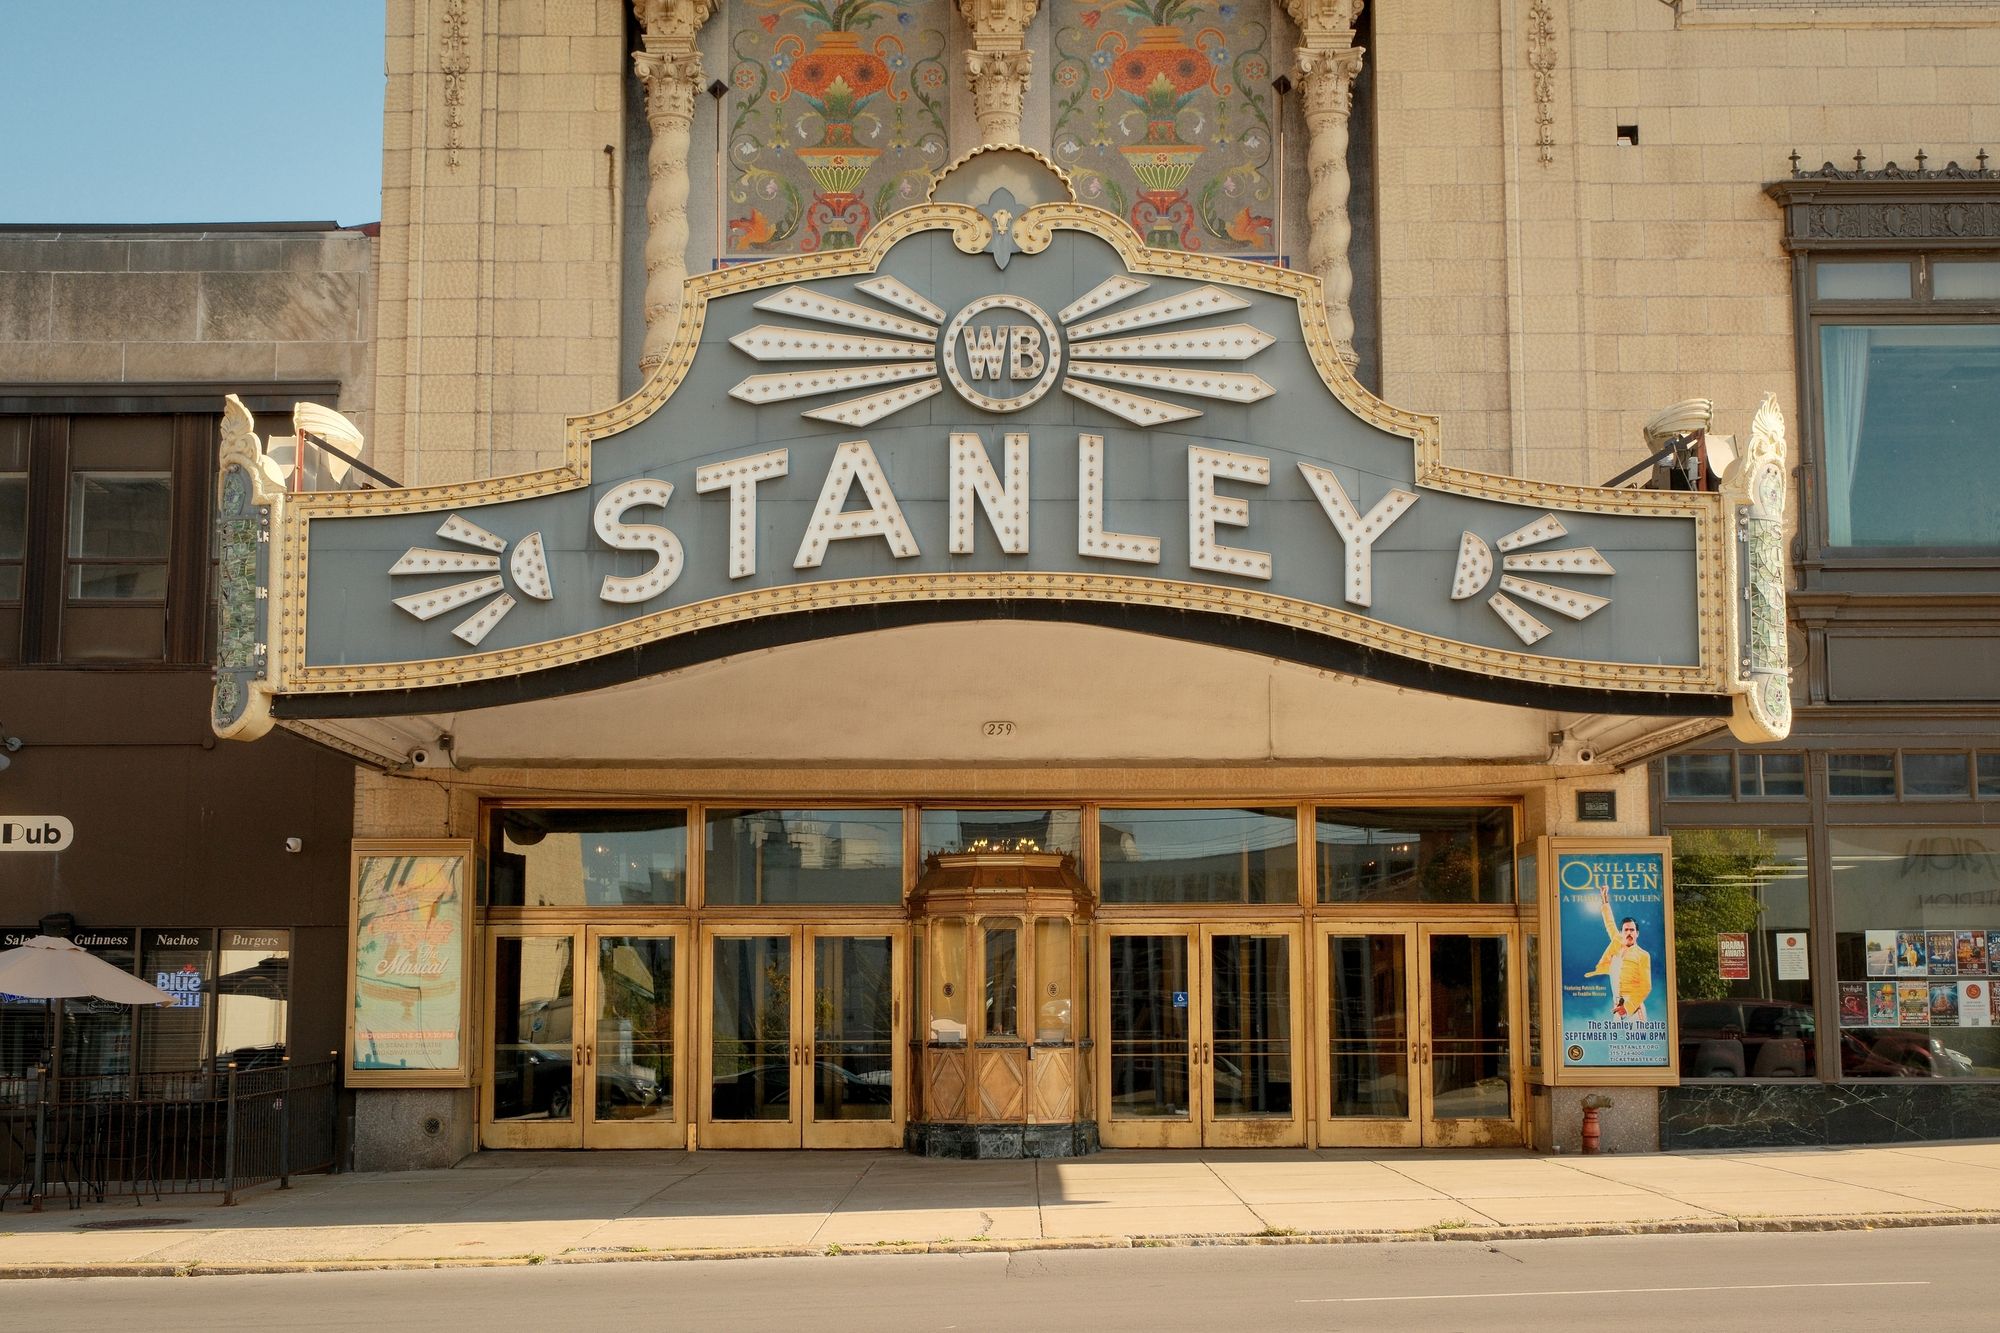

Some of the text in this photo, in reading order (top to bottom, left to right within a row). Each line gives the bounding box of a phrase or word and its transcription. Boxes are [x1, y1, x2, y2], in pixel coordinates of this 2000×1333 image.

[963, 325, 1045, 380] WB
[593, 432, 1420, 607] STANLEY
[987, 723, 1012, 736] 259
[3, 823, 62, 844] Pub
[1593, 863, 1658, 872] KILLER
[1561, 861, 1658, 890] QUEEN
[1628, 895, 1661, 903] QUEEN
[73, 934, 129, 945] Guinness
[156, 934, 199, 946] Nachos
[232, 934, 279, 947] Burgers
[376, 954, 449, 976] Musical
[157, 972, 201, 991] Blue
[1588, 1021, 1666, 1030] The Stanley Theatre
[1565, 1032, 1607, 1040] SEPTEMBER
[1609, 1032, 1618, 1040] 19
[1626, 1032, 1647, 1040] SHOW
[1649, 1032, 1666, 1040] 8PM
